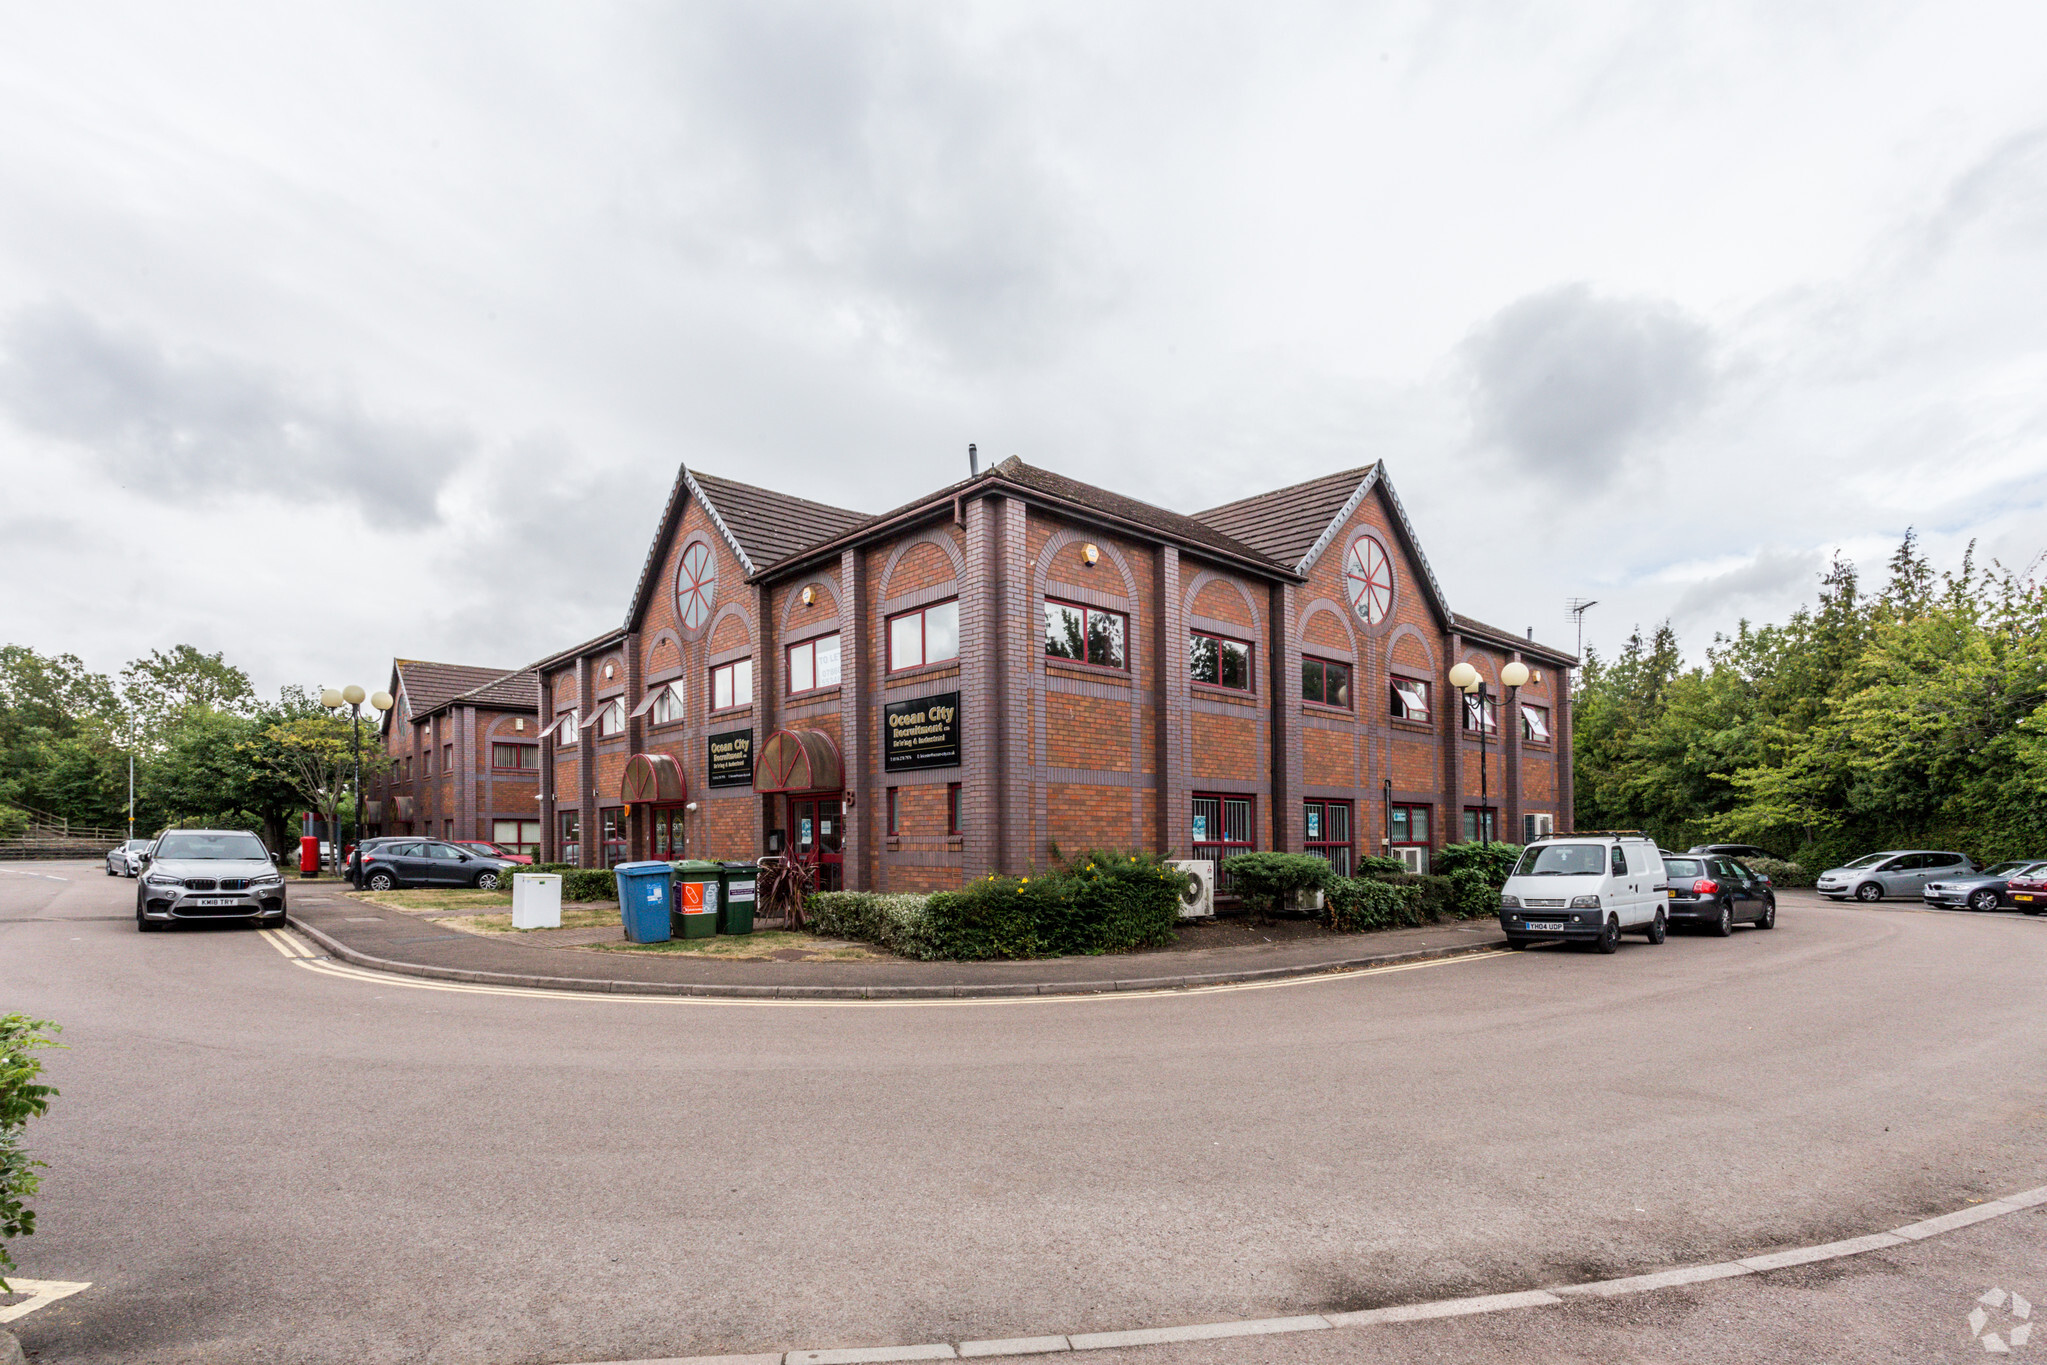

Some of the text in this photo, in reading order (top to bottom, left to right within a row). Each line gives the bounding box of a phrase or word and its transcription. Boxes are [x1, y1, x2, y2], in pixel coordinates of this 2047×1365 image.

[819, 655, 828, 664] TO
[889, 705, 955, 728] Ocean City
[893, 722, 943, 738] Recruitment
[711, 738, 750, 754] Ocean City
[713, 751, 743, 762] Recruitment
[846, 788, 855, 807] B
